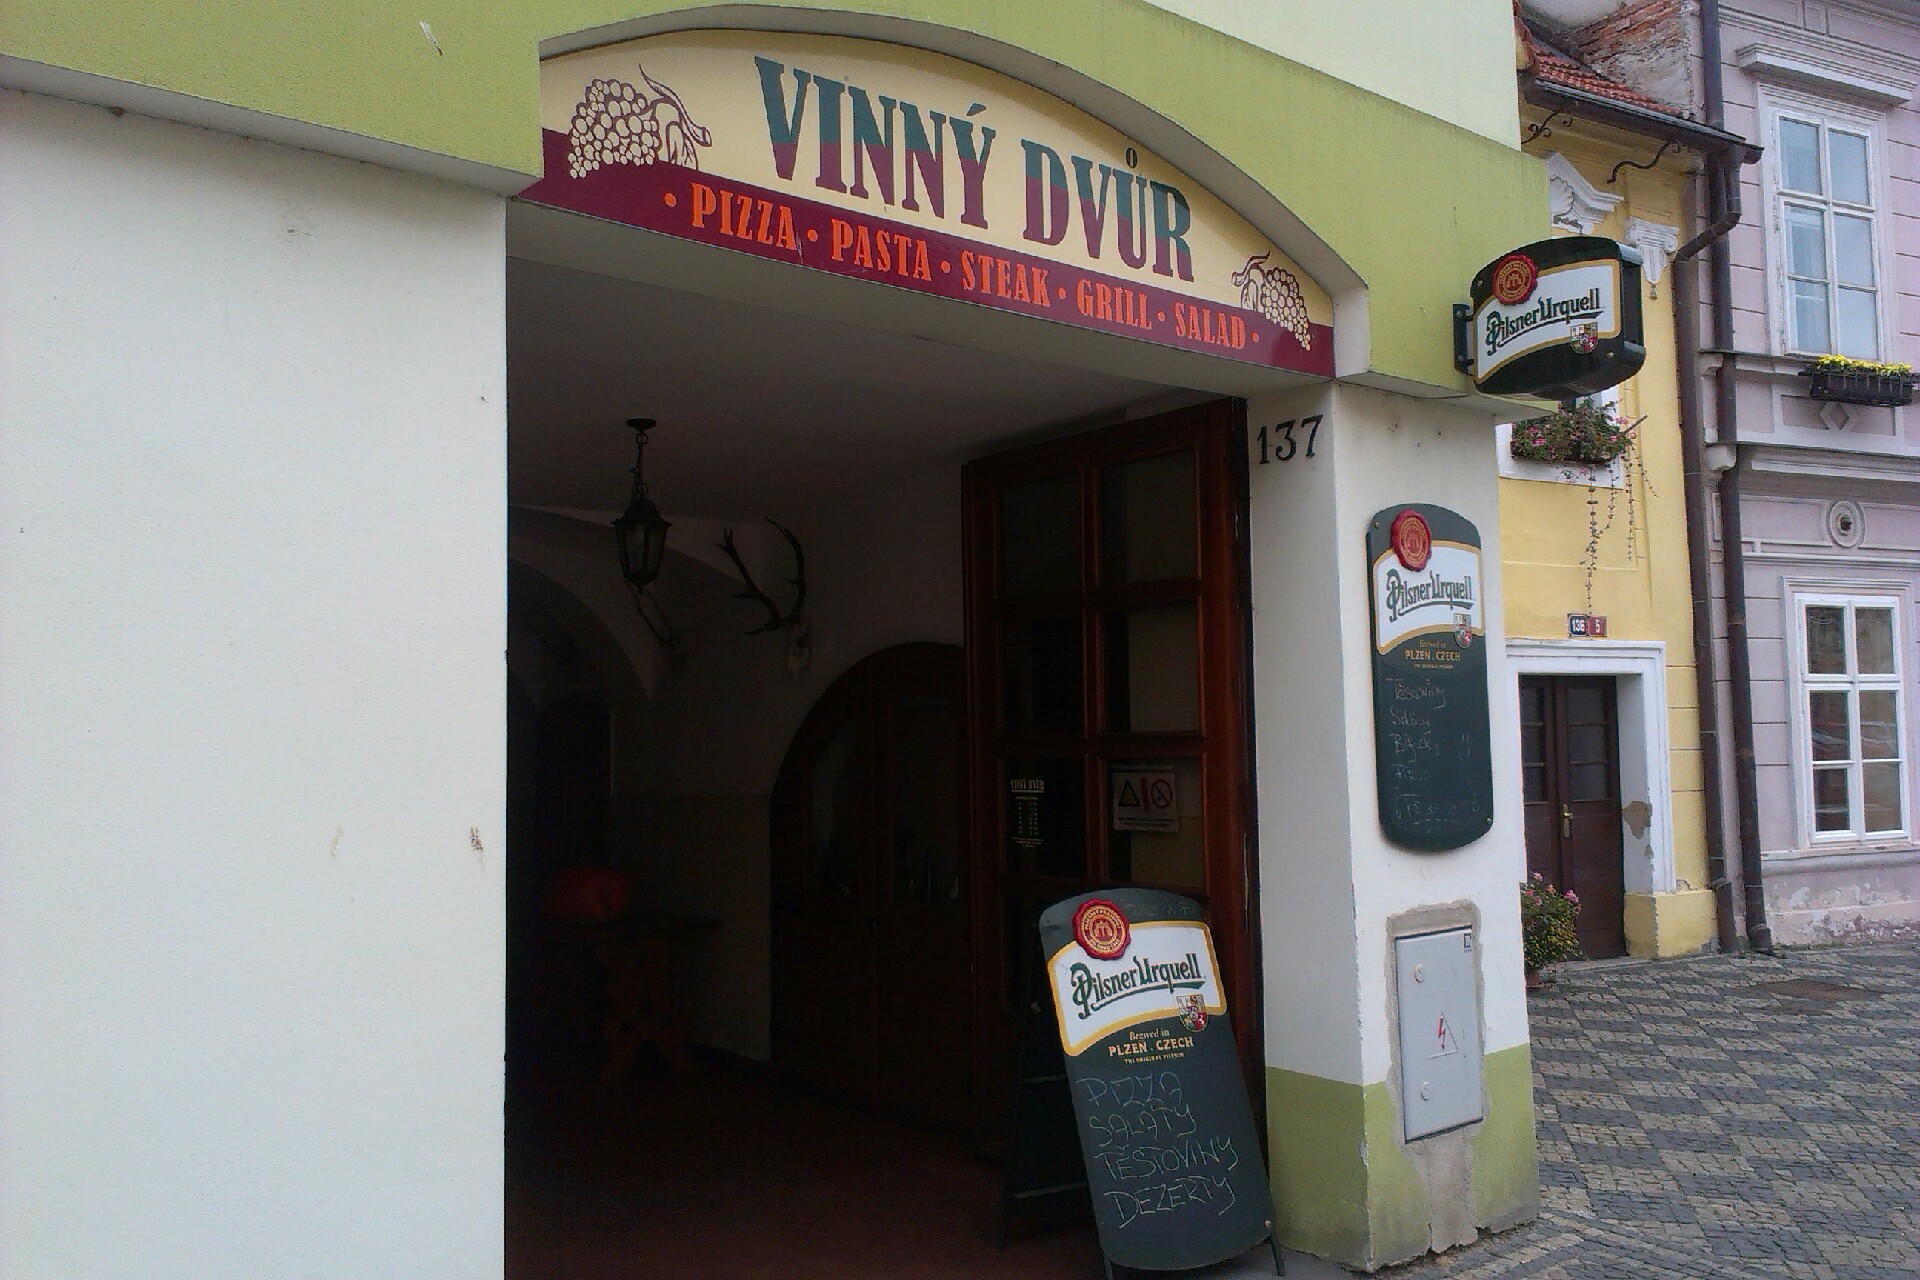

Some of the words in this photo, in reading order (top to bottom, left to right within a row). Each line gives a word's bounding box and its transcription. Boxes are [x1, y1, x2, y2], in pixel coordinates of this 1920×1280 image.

[754, 55, 996, 230] VINNÝ
[1021, 138, 1195, 283] DVŮR
[690, 181, 797, 251] PIZZA
[831, 217, 932, 282] PASTA
[961, 249, 1051, 307] STEAK
[1076, 278, 1153, 331] GRILL
[1174, 301, 1247, 351] SALAD
[1485, 307, 1539, 357] Pilsner
[1537, 287, 1601, 325] Urquell
[1256, 413, 1324, 465] 137
[1385, 567, 1432, 623] Pilsner
[1429, 569, 1474, 611] Urquell
[1571, 618, 1586, 632] 136
[1594, 618, 1601, 634] 5
[1435, 649, 1461, 661] CZECH
[1069, 961, 1138, 1020] Pilsner
[1133, 952, 1203, 995] Urquell
[1129, 1028, 1159, 1041] Brewed
[1161, 1028, 1170, 1038] in
[1155, 1036, 1194, 1051] CZECH
[1103, 1175, 1236, 1229] DEZERTY
